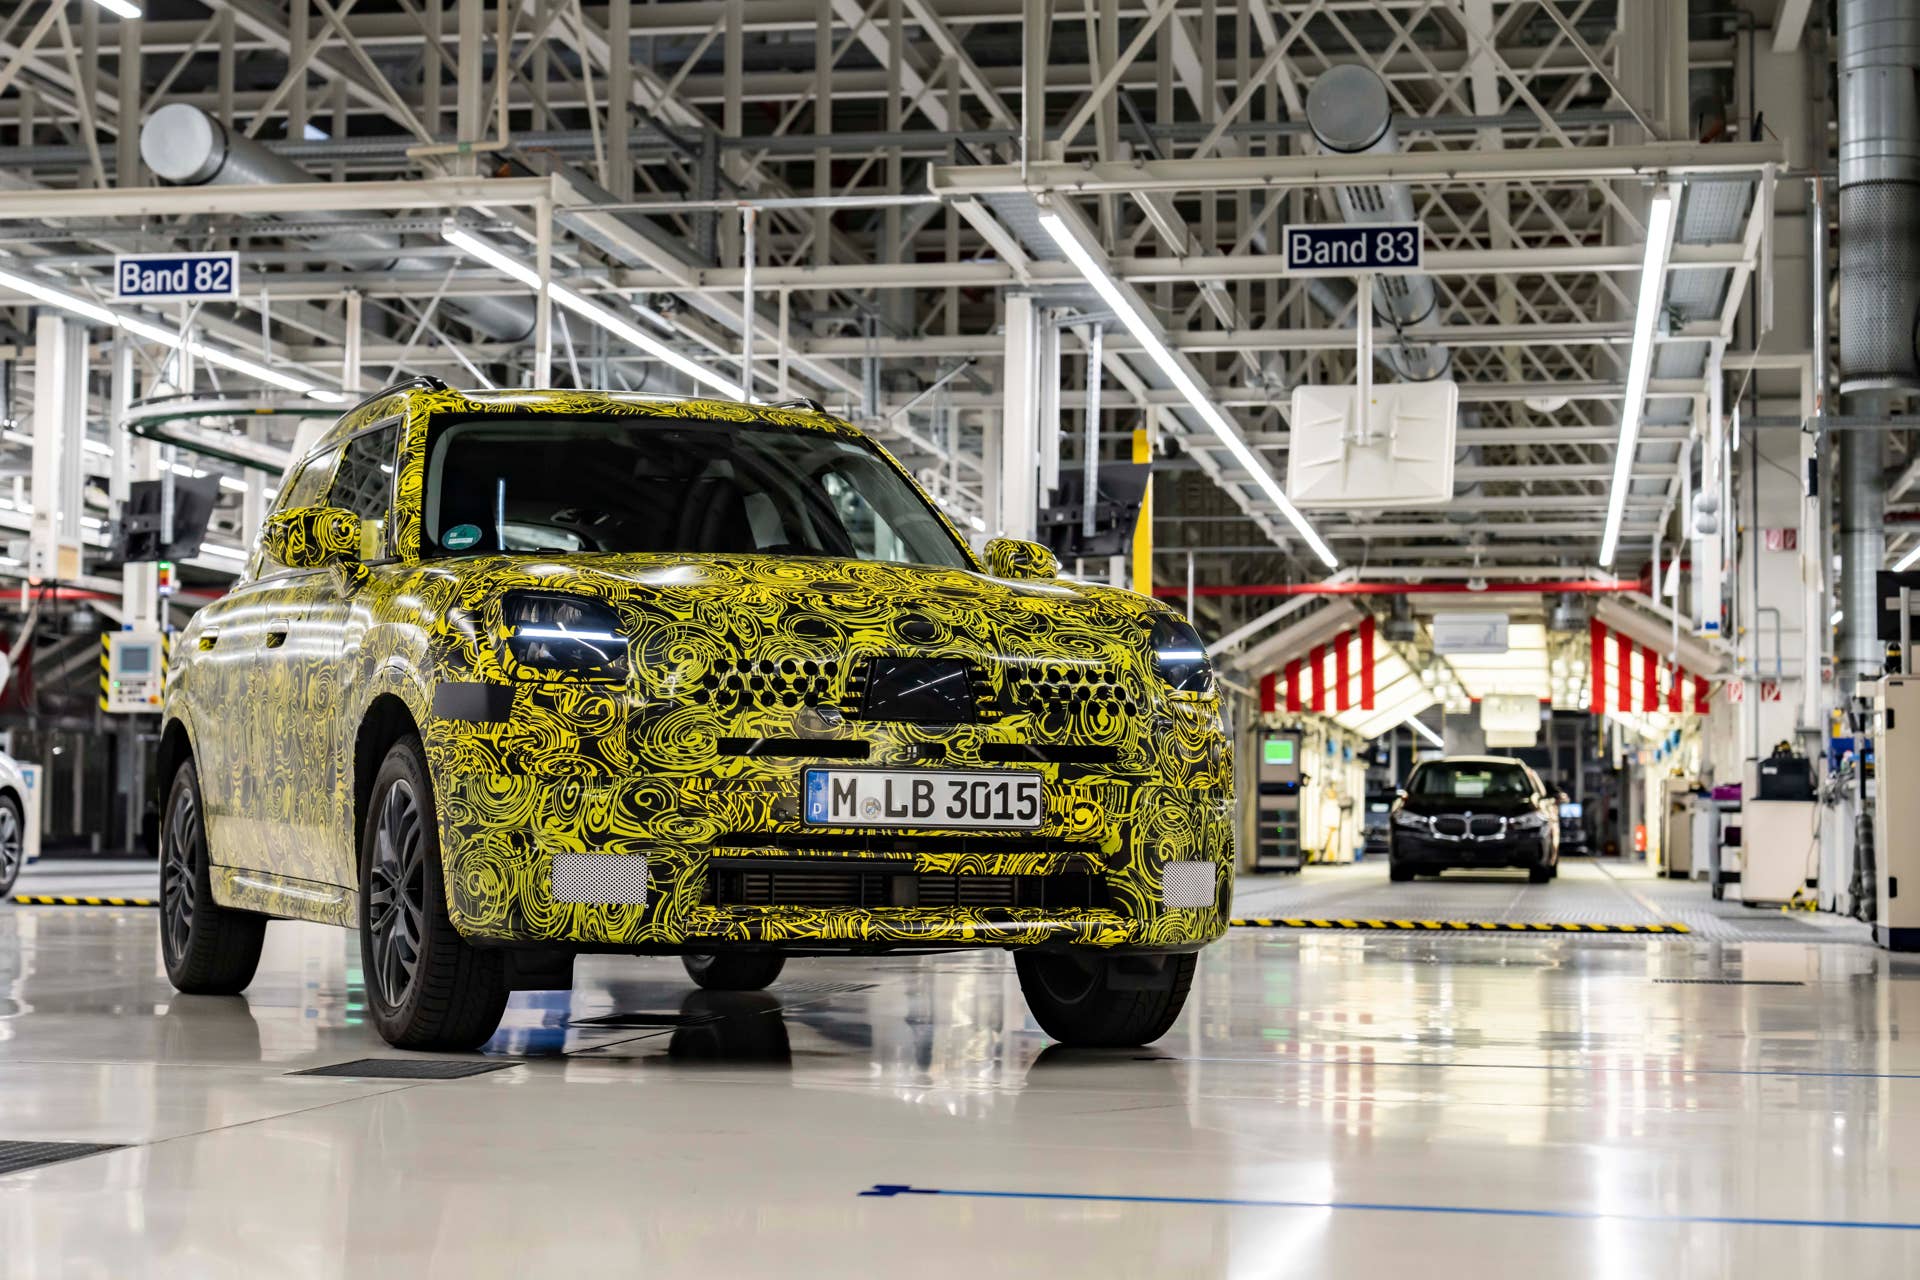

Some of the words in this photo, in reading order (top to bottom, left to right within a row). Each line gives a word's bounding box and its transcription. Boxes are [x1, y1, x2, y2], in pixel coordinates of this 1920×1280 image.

[1292, 232, 1367, 264] Band
[1376, 231, 1414, 263] 83
[122, 261, 189, 293] Band
[194, 261, 229, 291] 82
[813, 802, 822, 815] D
[832, 778, 857, 817] M
[884, 779, 935, 819] LB
[946, 781, 1037, 820] 3015
